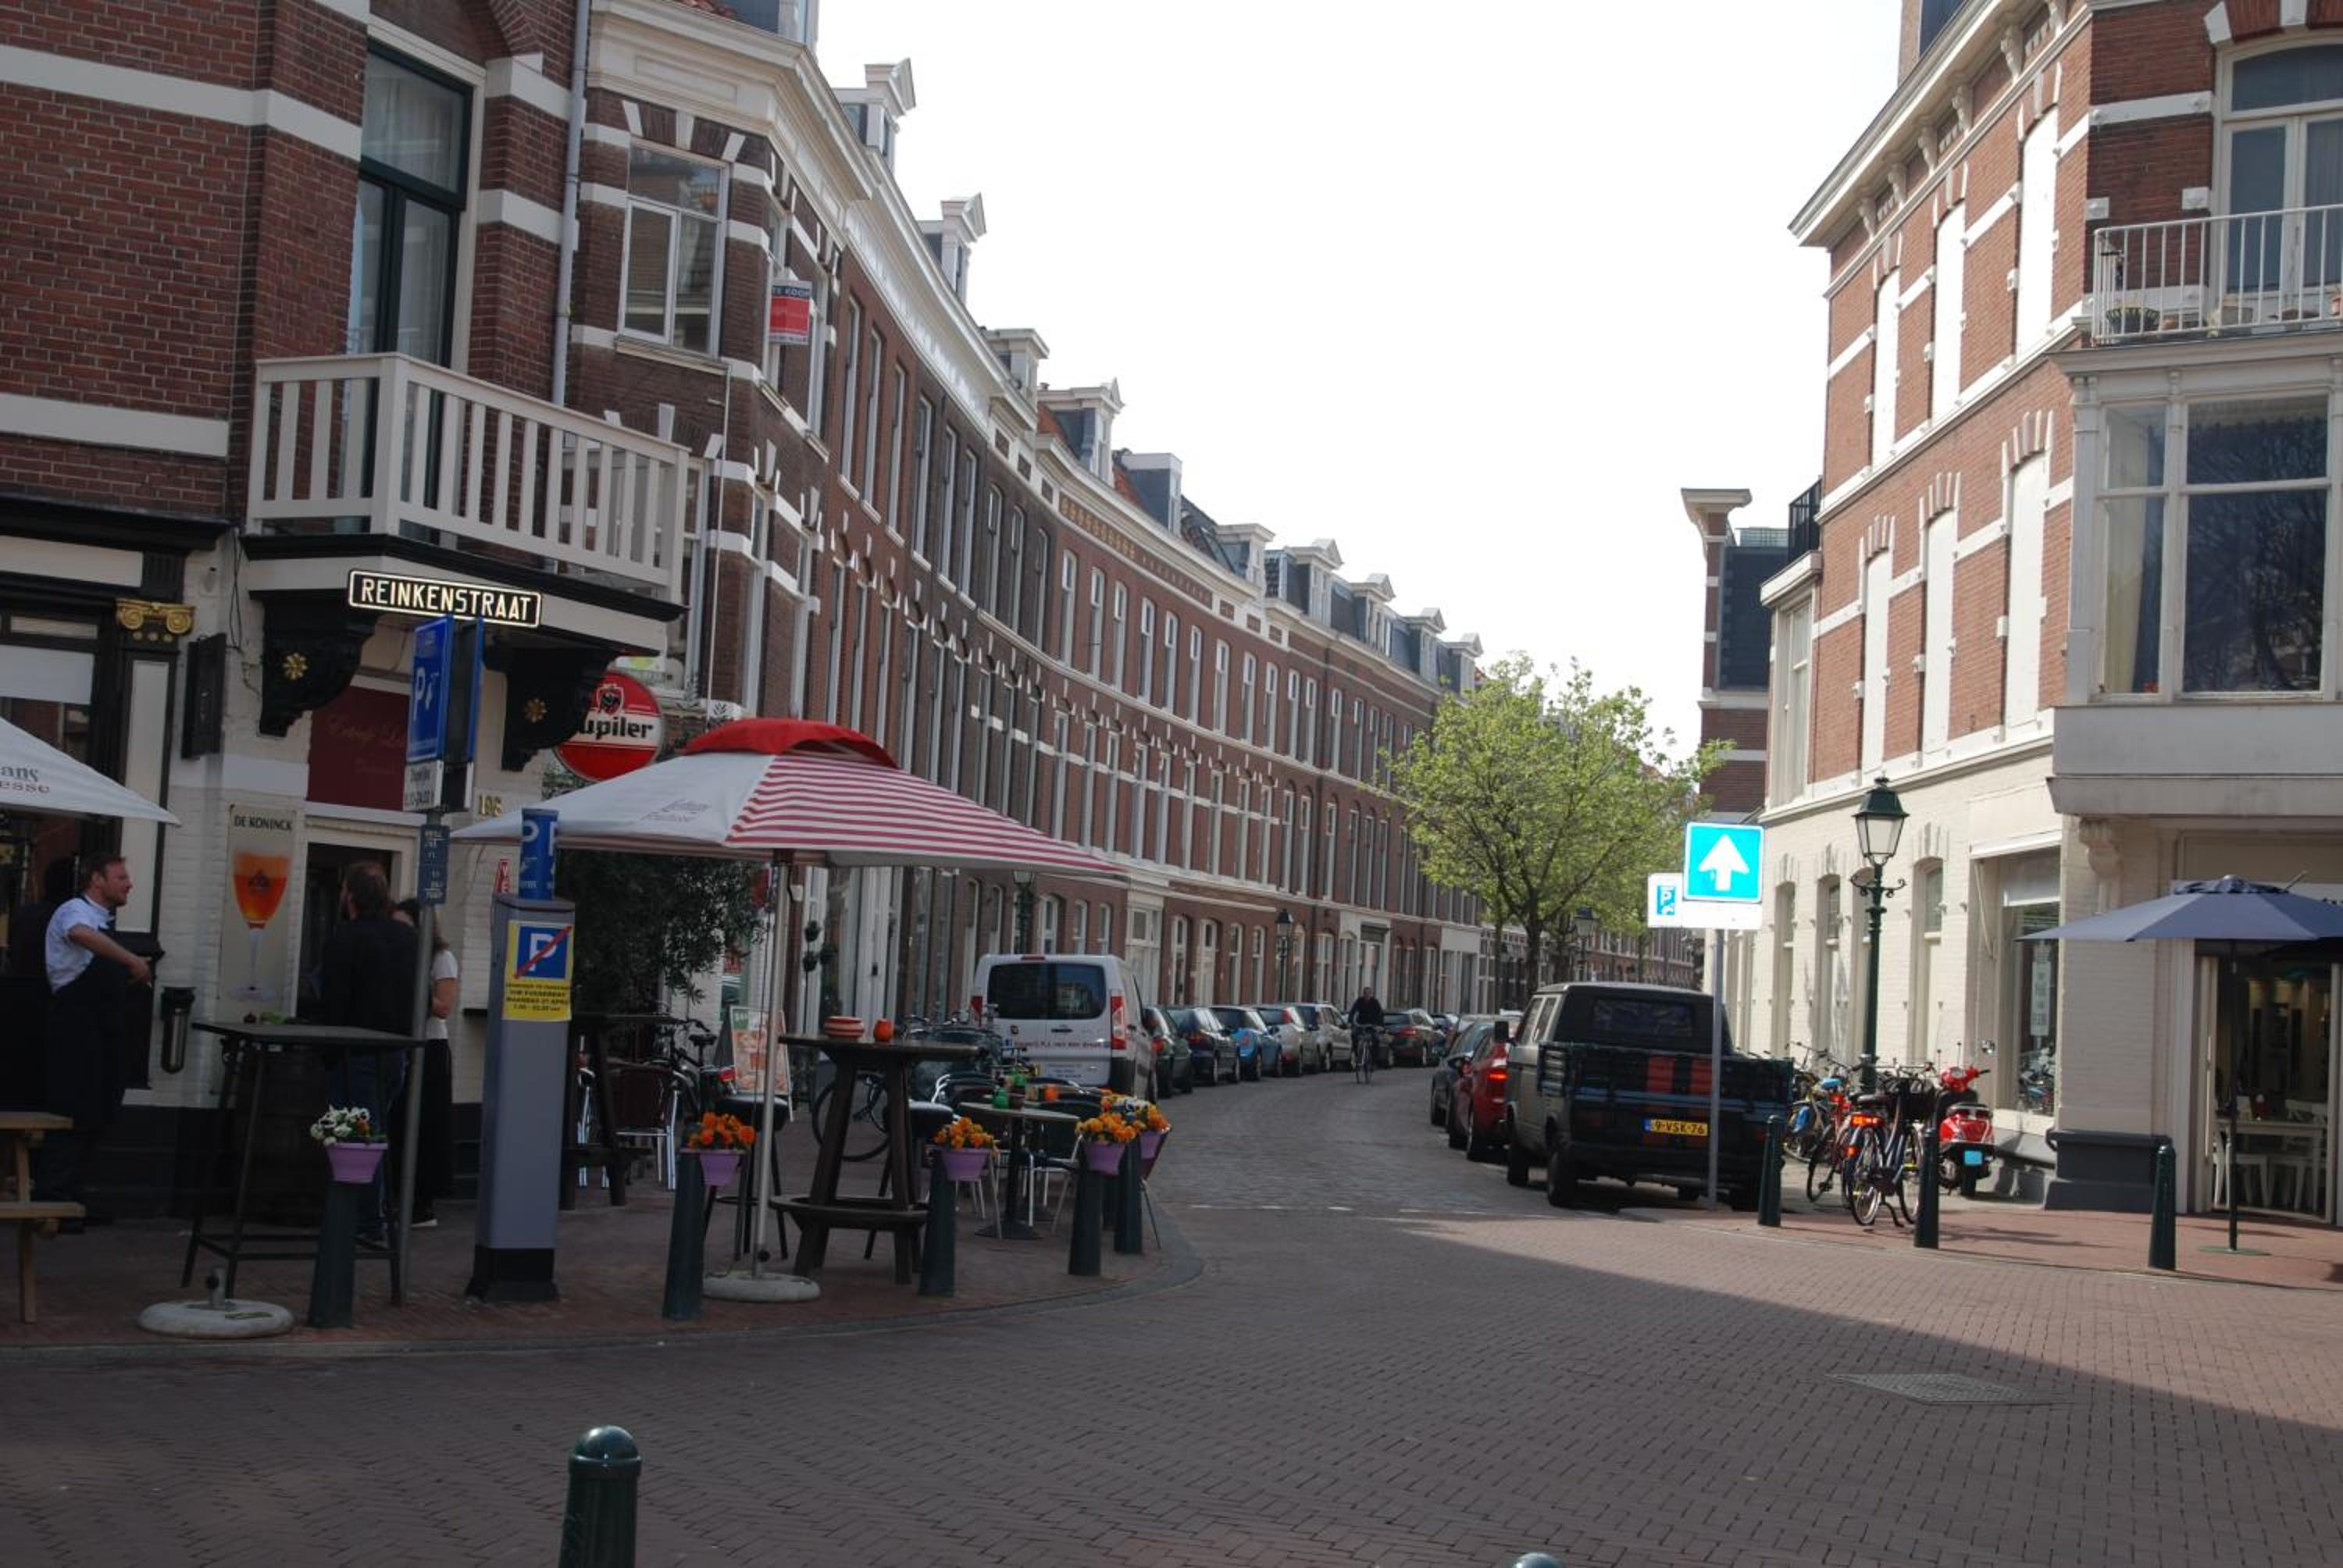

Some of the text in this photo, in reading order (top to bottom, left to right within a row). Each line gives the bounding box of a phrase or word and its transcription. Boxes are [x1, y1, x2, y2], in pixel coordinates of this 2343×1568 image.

[361, 578, 531, 621] REINKENSTRAAT
[579, 715, 654, 740] upiler
[234, 814, 293, 832] DE KONINCK
